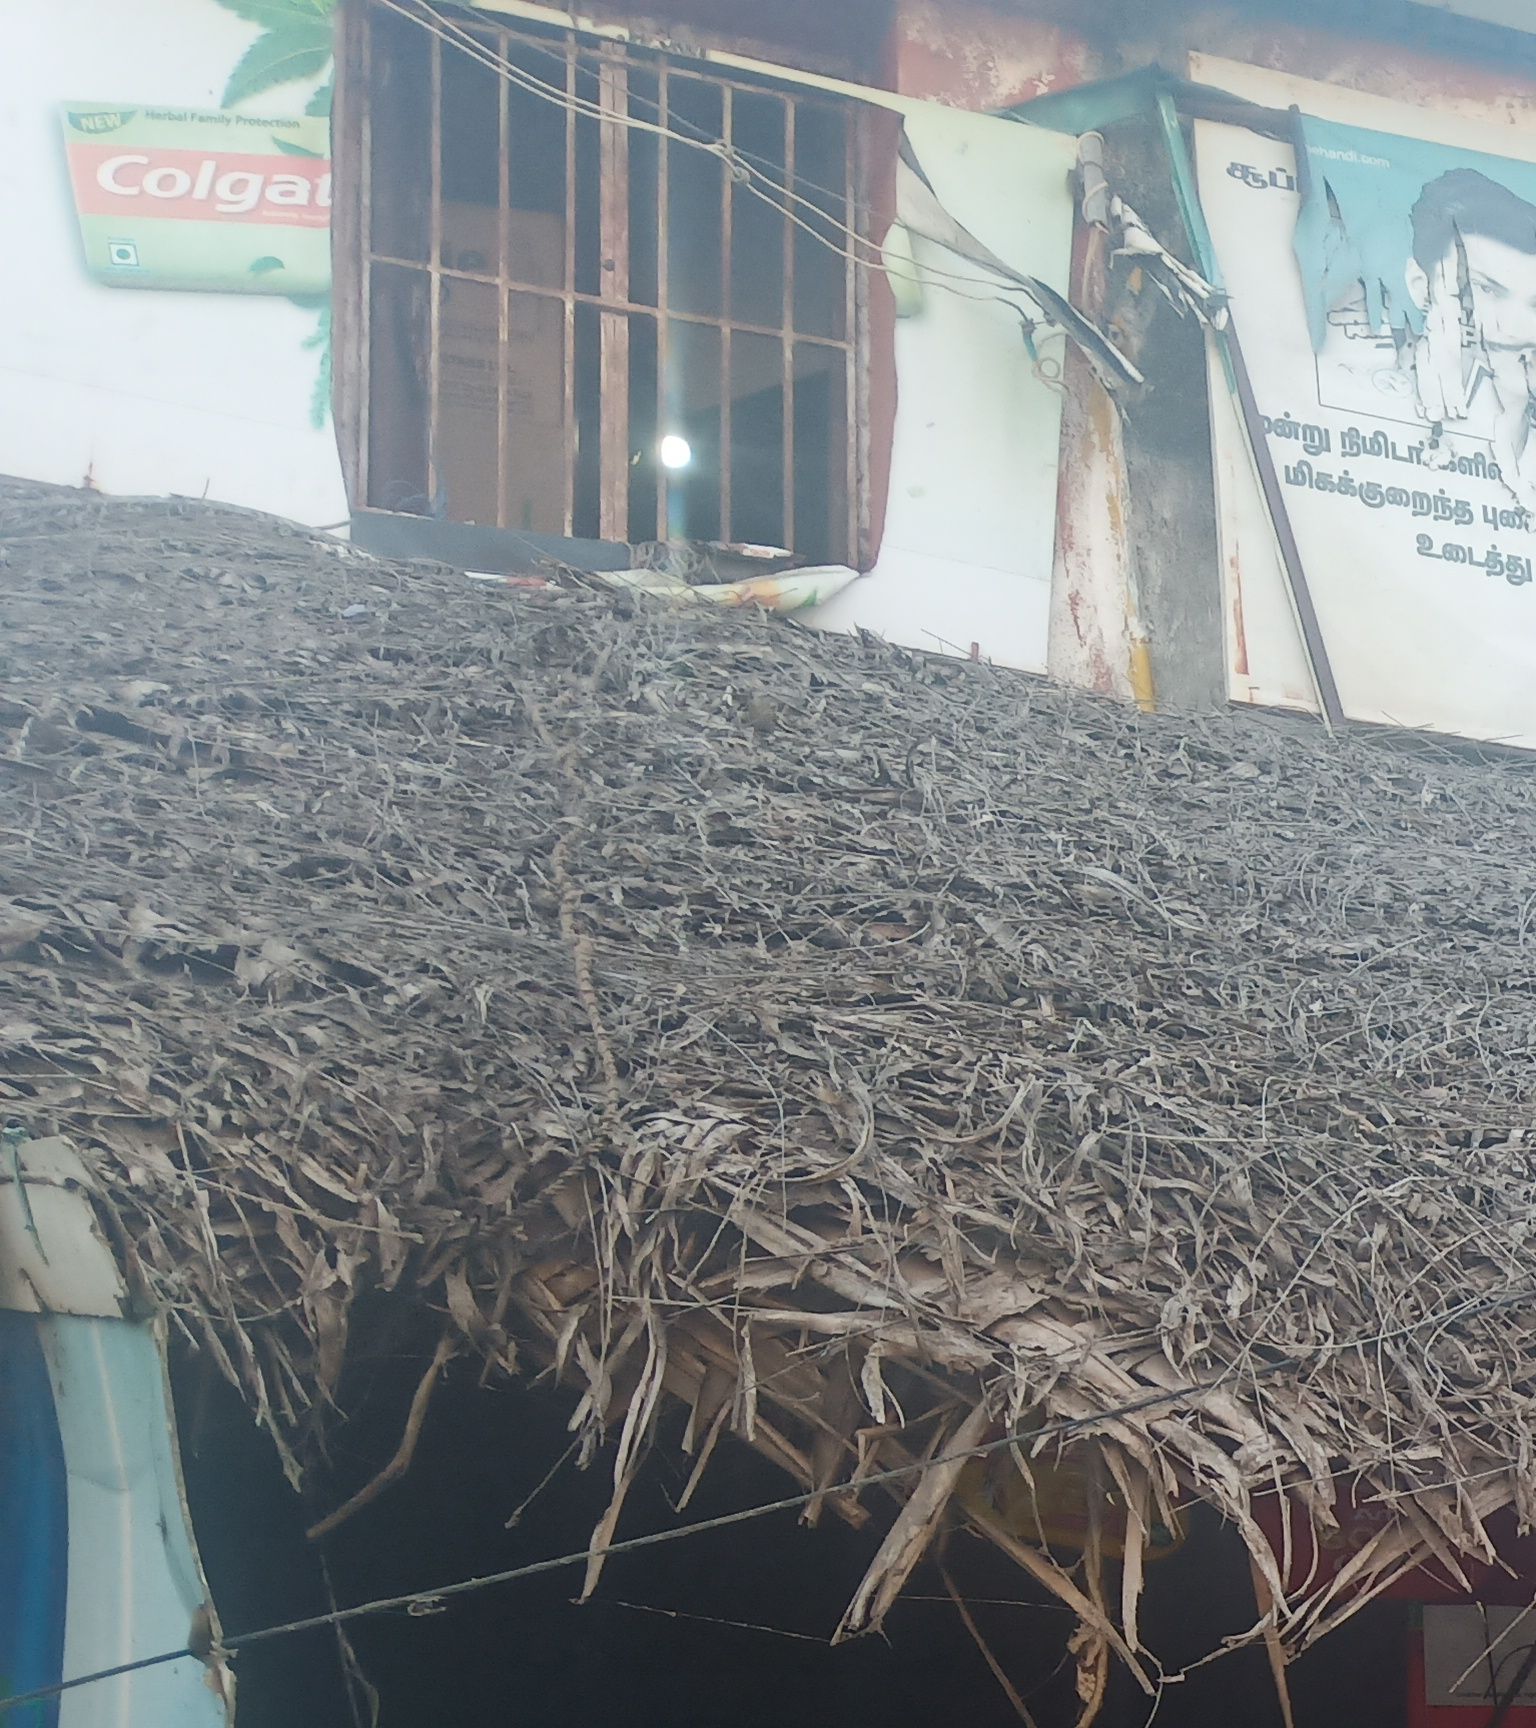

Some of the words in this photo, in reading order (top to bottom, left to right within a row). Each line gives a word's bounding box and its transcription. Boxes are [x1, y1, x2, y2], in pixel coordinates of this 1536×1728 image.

[80, 112, 121, 131] NEW
[144, 110, 188, 123] Herbal
[190, 112, 231, 127] Family
[235, 114, 301, 129] Protection
[96, 154, 332, 214] Colgat
[1284, 460, 1474, 526] மிகக்குறைந்த
[1415, 532, 1533, 586] உடைத்து
